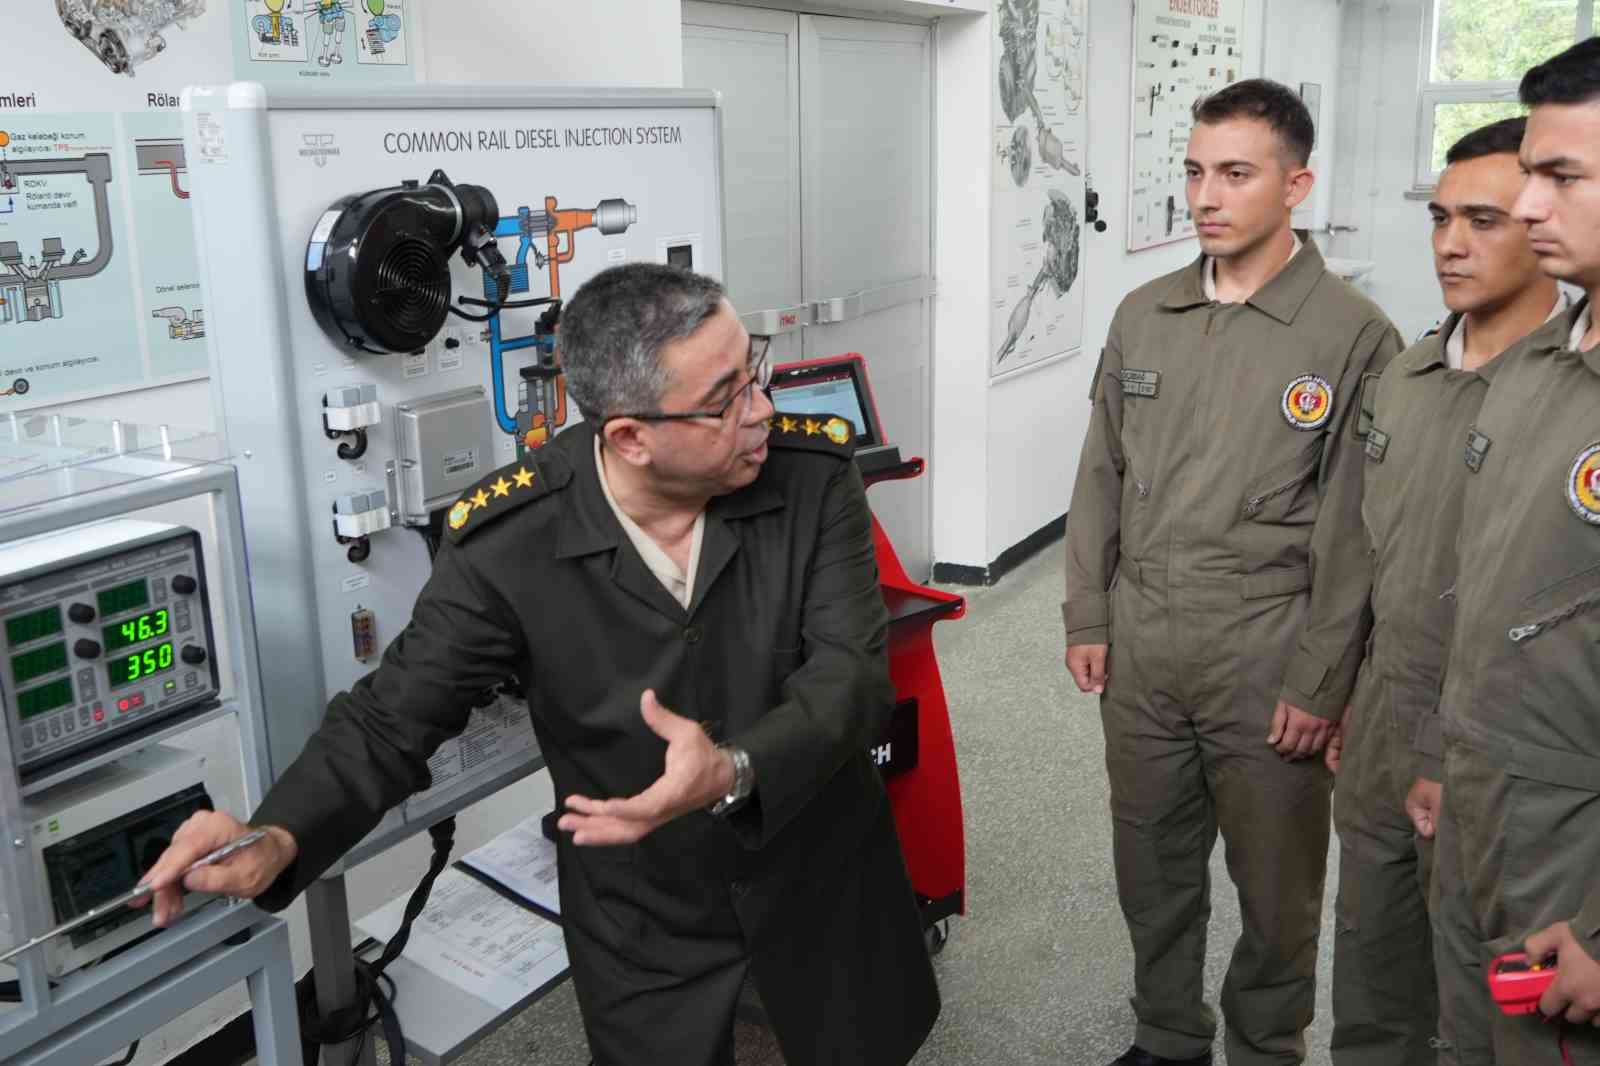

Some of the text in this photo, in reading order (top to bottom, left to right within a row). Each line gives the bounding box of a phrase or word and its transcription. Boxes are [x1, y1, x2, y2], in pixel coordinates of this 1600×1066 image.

[383, 126, 682, 154] COMMON RAIL DIESEL INJECTION SYSTEM
[121, 610, 167, 641] 46.3
[128, 643, 172, 680] 350
